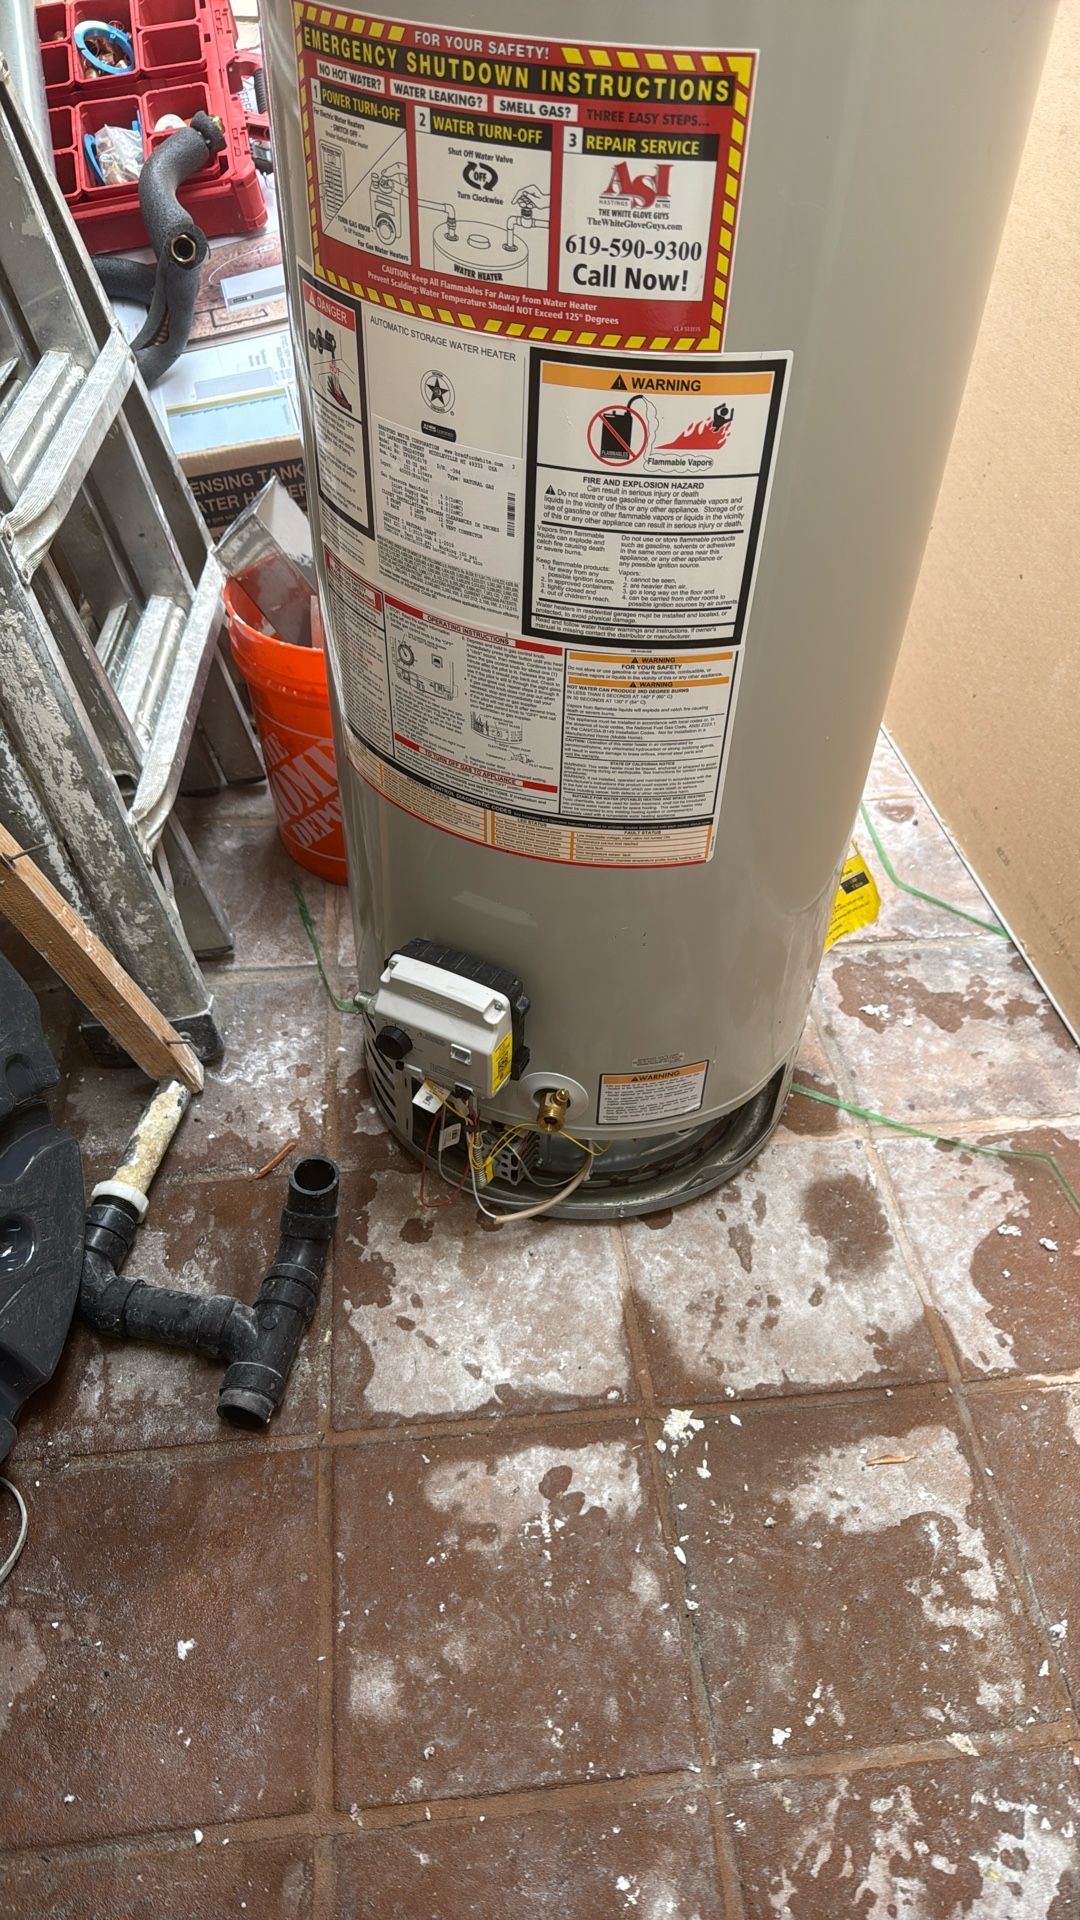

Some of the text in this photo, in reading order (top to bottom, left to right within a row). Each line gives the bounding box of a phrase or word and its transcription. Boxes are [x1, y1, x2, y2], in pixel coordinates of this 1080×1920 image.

[414, 31, 549, 60] FOR YOUR SAFETY!
[304, 26, 730, 102] EMERGENCY SHUTDOWN INSTRUCTIONS
[319, 63, 382, 90] NO HOT WATER?
[313, 86, 401, 121] 1 POWER TURN-OFF
[394, 82, 483, 108] WATER LEAKING?
[500, 100, 572, 118] SMELL GAS?
[587, 108, 710, 128] THREE EASY STEPS...
[420, 113, 542, 144] 2 WATER TURN-OFF
[568, 133, 700, 156] 3 REPAIR SERVICE
[448, 148, 513, 164] Shut Off Water Valve
[473, 171, 487, 182] OFF
[457, 191, 504, 205] Turn Clockwise
[599, 208, 669, 220] THE WHITE GLOVE GUYS
[587, 217, 682, 231] TheWhiteGloveGuys.com
[565, 235, 702, 261] 619-590-9300
[454, 264, 503, 281] WATER HEATER
[573, 263, 688, 291] Call Now!
[382, 264, 597, 311] CAUTION: Keep All Flammables Far Away from Water Heater
[367, 271, 619, 325] Prevent Scalding: Water Temperature Should NOT Exceed 125° Degrees
[316, 296, 347, 324] DANGER
[370, 316, 516, 362] AUTOMATIC STORAGE WATER HEATER
[632, 376, 702, 392] WARNING
[648, 458, 712, 467] Flammable Vapors
[189, 473, 254, 496] ENSING
[622, 480, 669, 489] EXPLOSION
[654, 490, 671, 498] injury
[198, 494, 240, 513] ATER
[544, 495, 564, 504] liquids
[585, 501, 606, 510] vicinity
[637, 506, 648, 514] any
[620, 496, 646, 505] gasoline
[564, 508, 590, 516] gasoline
[619, 512, 651, 520] flammable
[684, 514, 704, 522] liquids
[724, 512, 744, 520] vicinity
[603, 519, 633, 527] appliance
[427, 615, 509, 645] OPERATING INSTRUCTIONS
[639, 1071, 680, 1082] WARNING
